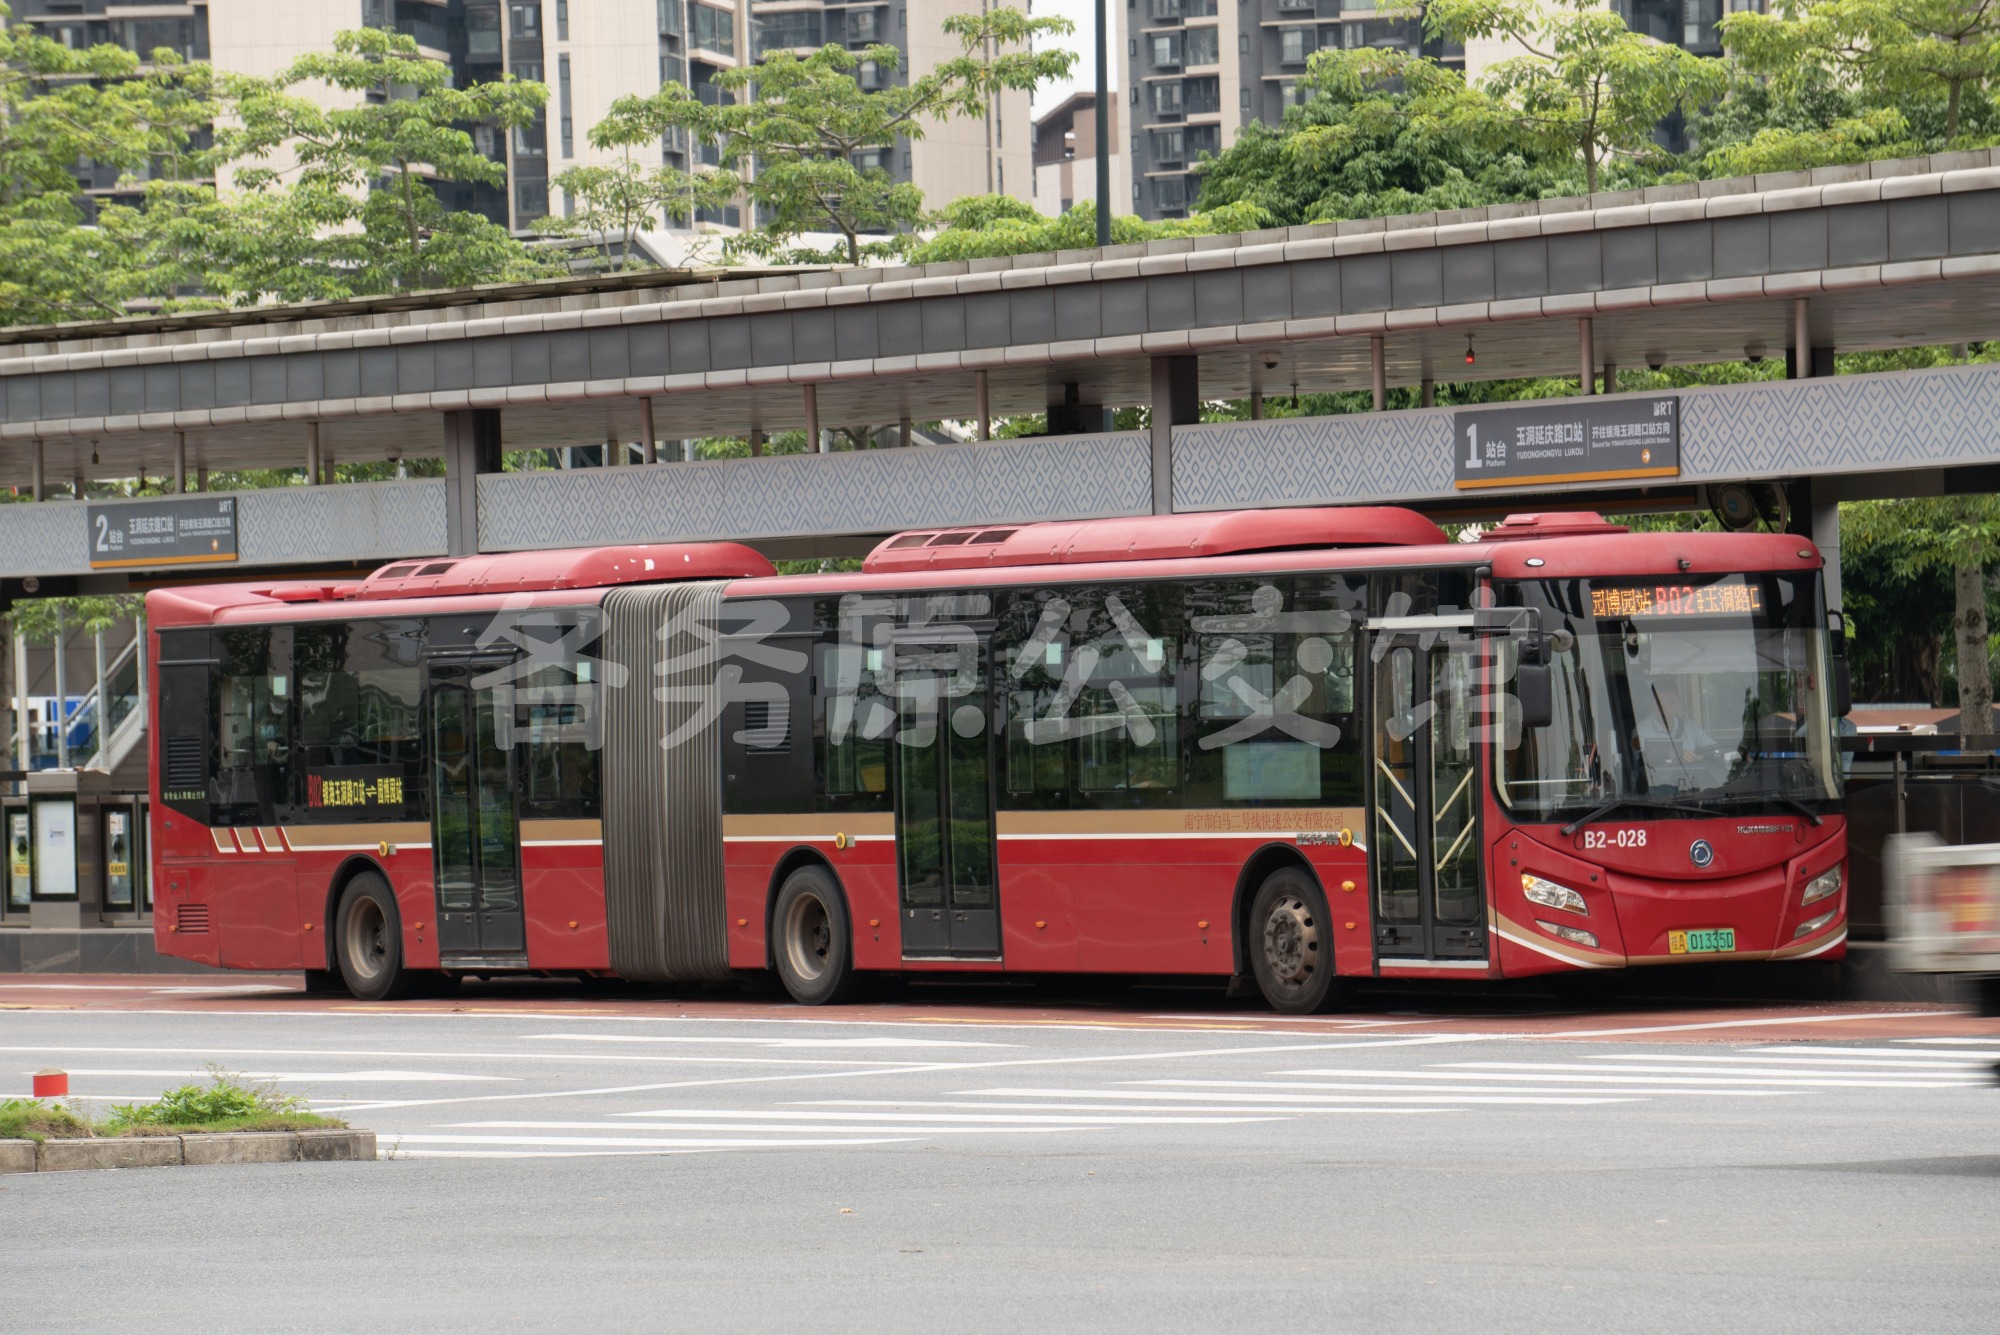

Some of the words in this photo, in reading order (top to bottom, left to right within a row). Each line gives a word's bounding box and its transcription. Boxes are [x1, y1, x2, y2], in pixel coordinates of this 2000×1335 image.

[1653, 401, 1673, 417] BRT
[1516, 421, 1583, 447] 玉洞延庆路口站
[1592, 421, 1671, 438] 开往银海玉洞路口站方向
[1465, 423, 1482, 469] 1
[1486, 440, 1507, 459] 站台
[1564, 447, 1584, 458] LUKOU
[1486, 459, 1506, 467] Platform
[95, 514, 109, 552] 2
[109, 529, 123, 544] 站台
[1591, 588, 1652, 617] 园博园站
[1655, 585, 1695, 615] B02
[307, 774, 322, 808] B02
[377, 776, 403, 804] 园博园站
[1184, 811, 1343, 831] 南宁市白马二号线快速公交有限公司
[1584, 829, 1647, 849] B2-028
[1690, 932, 1734, 950] 01335D
